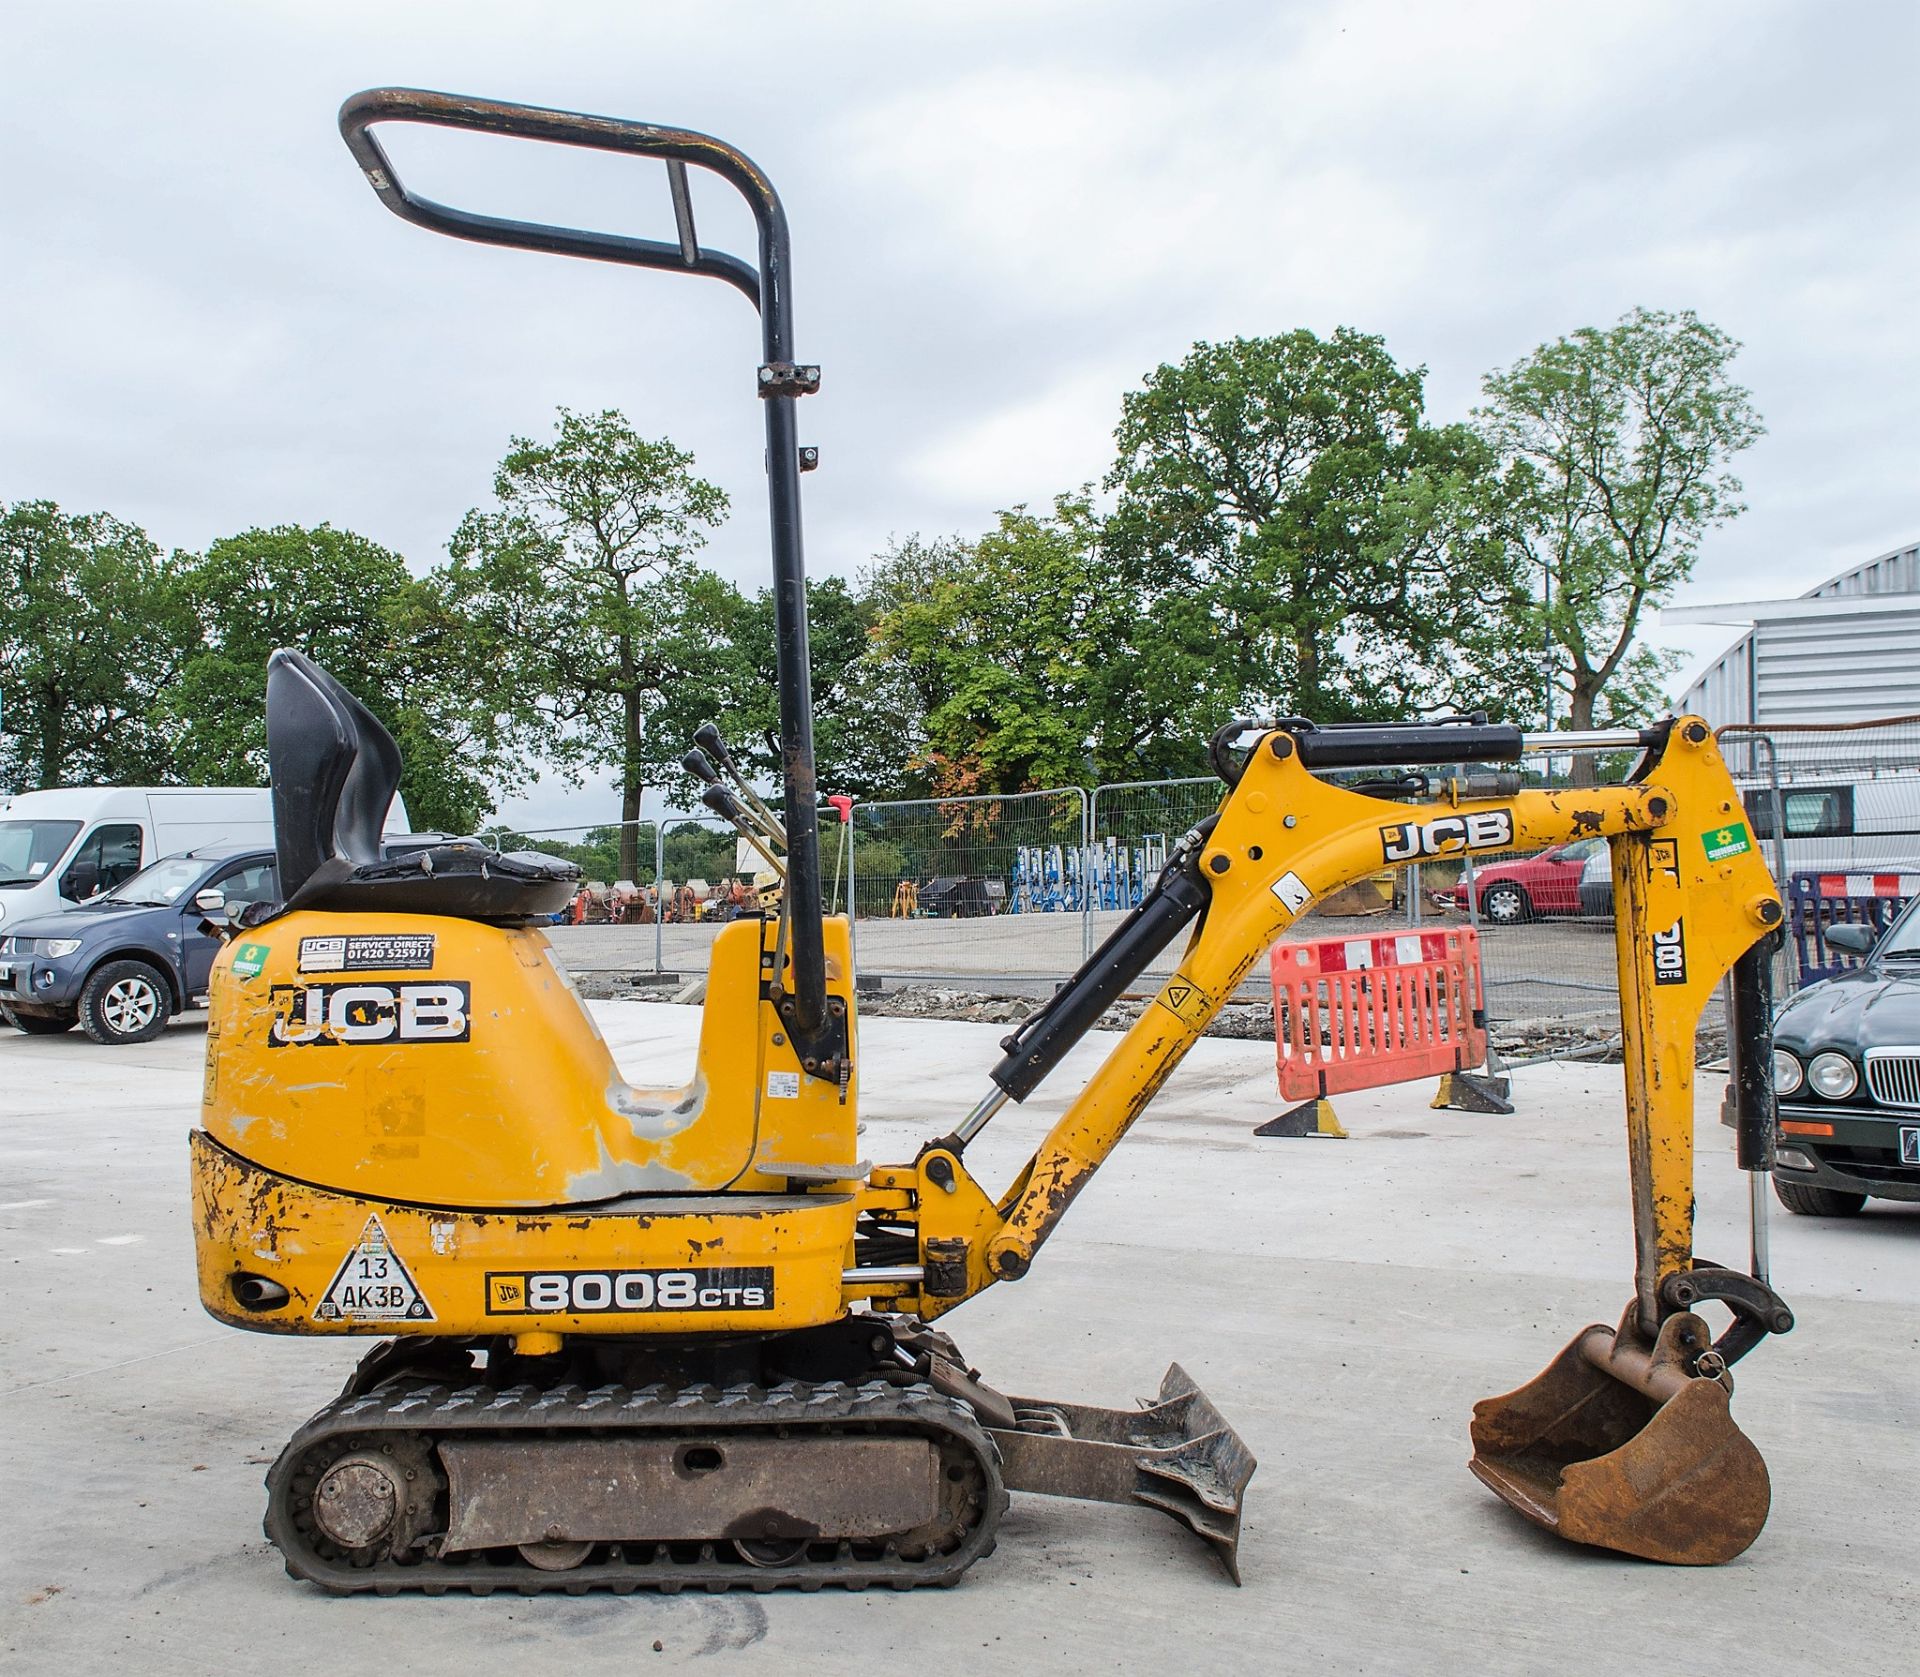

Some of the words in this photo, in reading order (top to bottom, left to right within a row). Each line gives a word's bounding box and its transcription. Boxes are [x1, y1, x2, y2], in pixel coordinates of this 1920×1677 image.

[1383, 812, 1511, 861] JCB
[306, 940, 342, 951] JCB
[347, 949, 384, 959] 01420
[387, 948, 430, 958] 525917
[348, 941, 391, 950] SERVICE
[393, 940, 432, 949] DIRECT
[1658, 970, 1682, 978] CTS
[273, 986, 467, 1041] JCB
[359, 1258, 387, 1279] 13
[342, 1286, 405, 1308] AK3B
[499, 1283, 520, 1303] JCB
[529, 1272, 697, 1310] 8008
[699, 1287, 765, 1307] CTS
